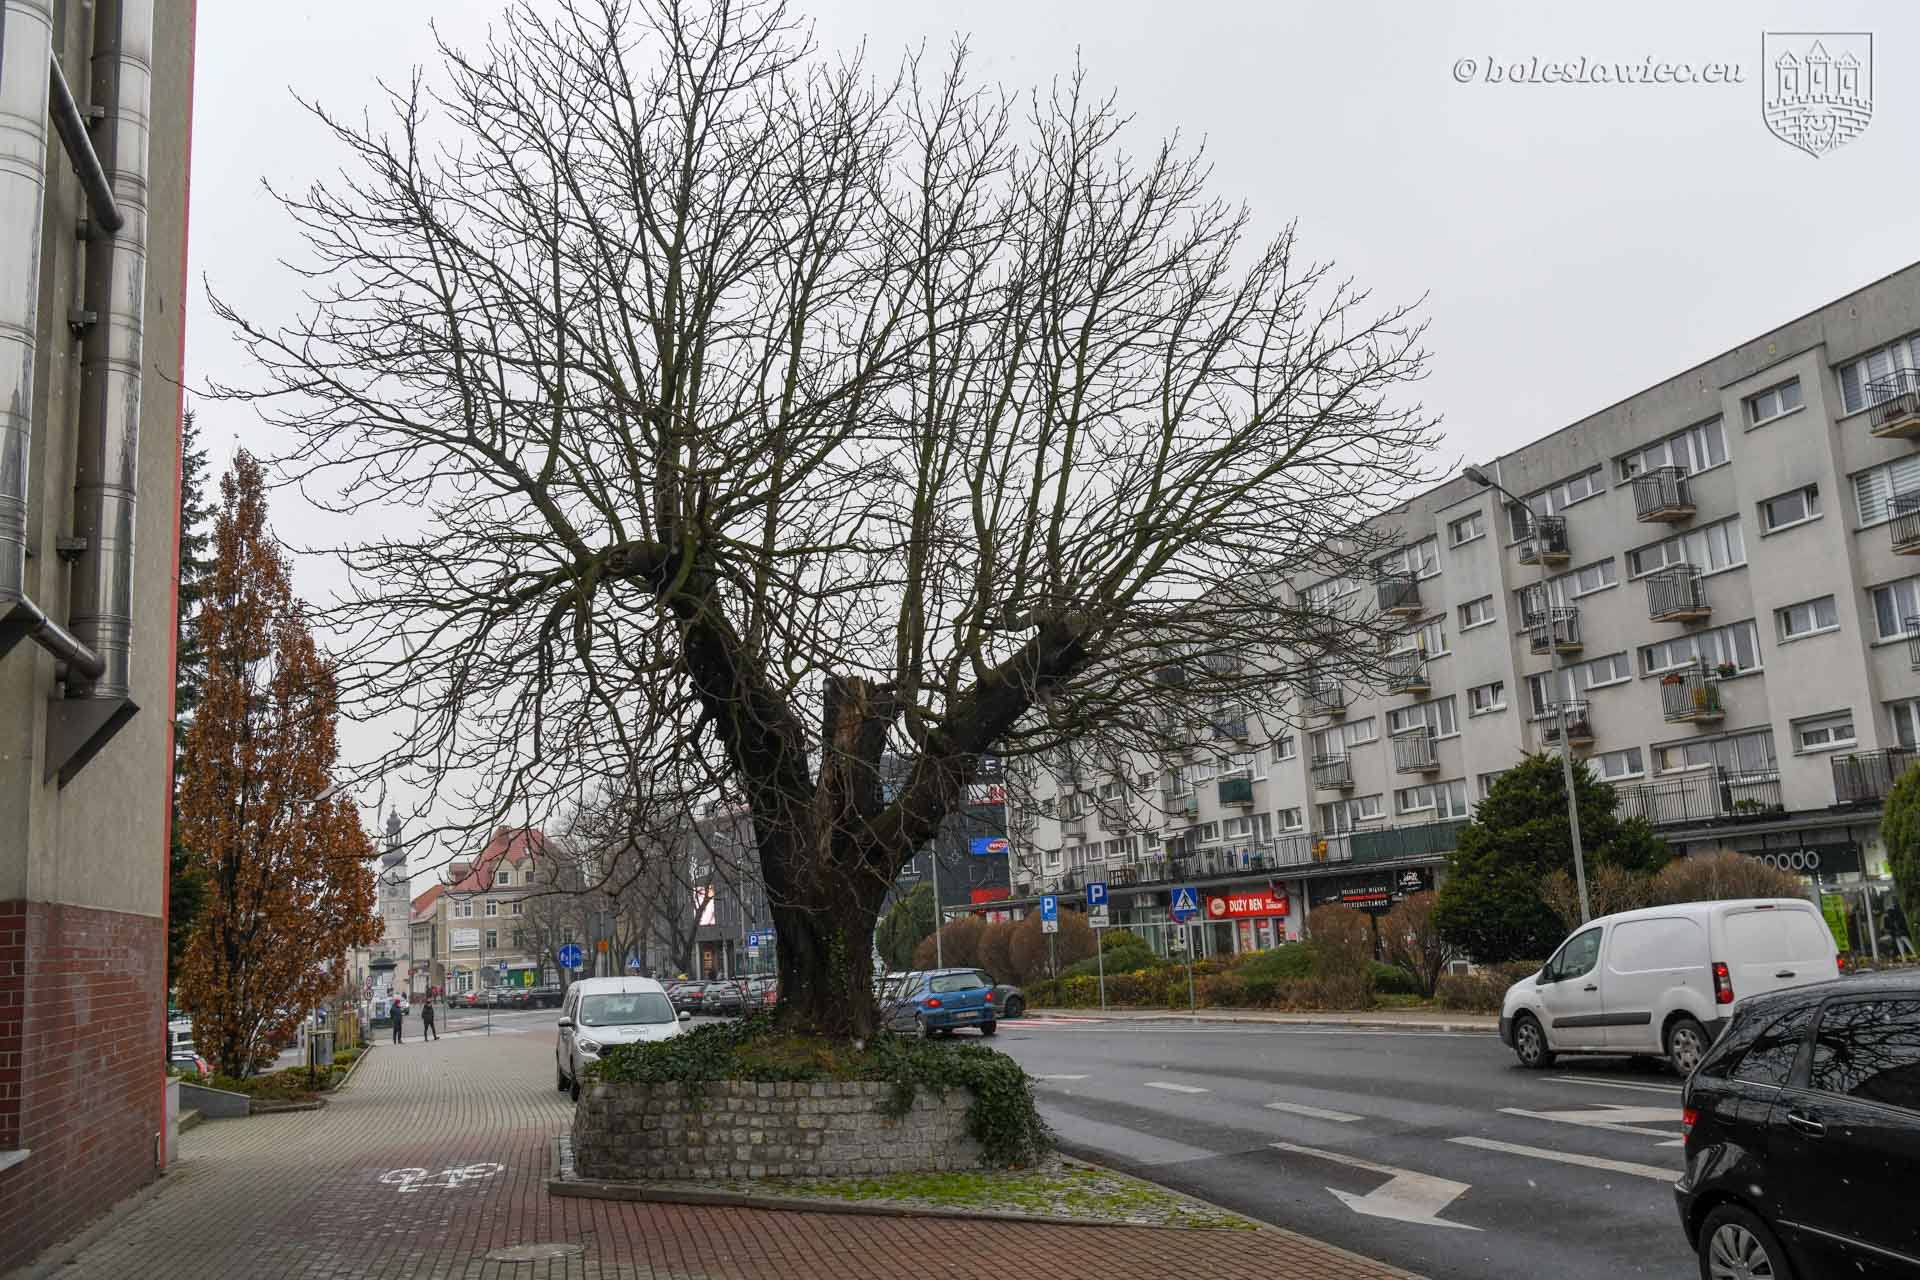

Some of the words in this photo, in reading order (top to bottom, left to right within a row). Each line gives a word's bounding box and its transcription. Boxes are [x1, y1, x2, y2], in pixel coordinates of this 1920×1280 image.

[1091, 884, 1104, 903] P
[1043, 897, 1054, 913] P
[1249, 898, 1263, 911] BEN
